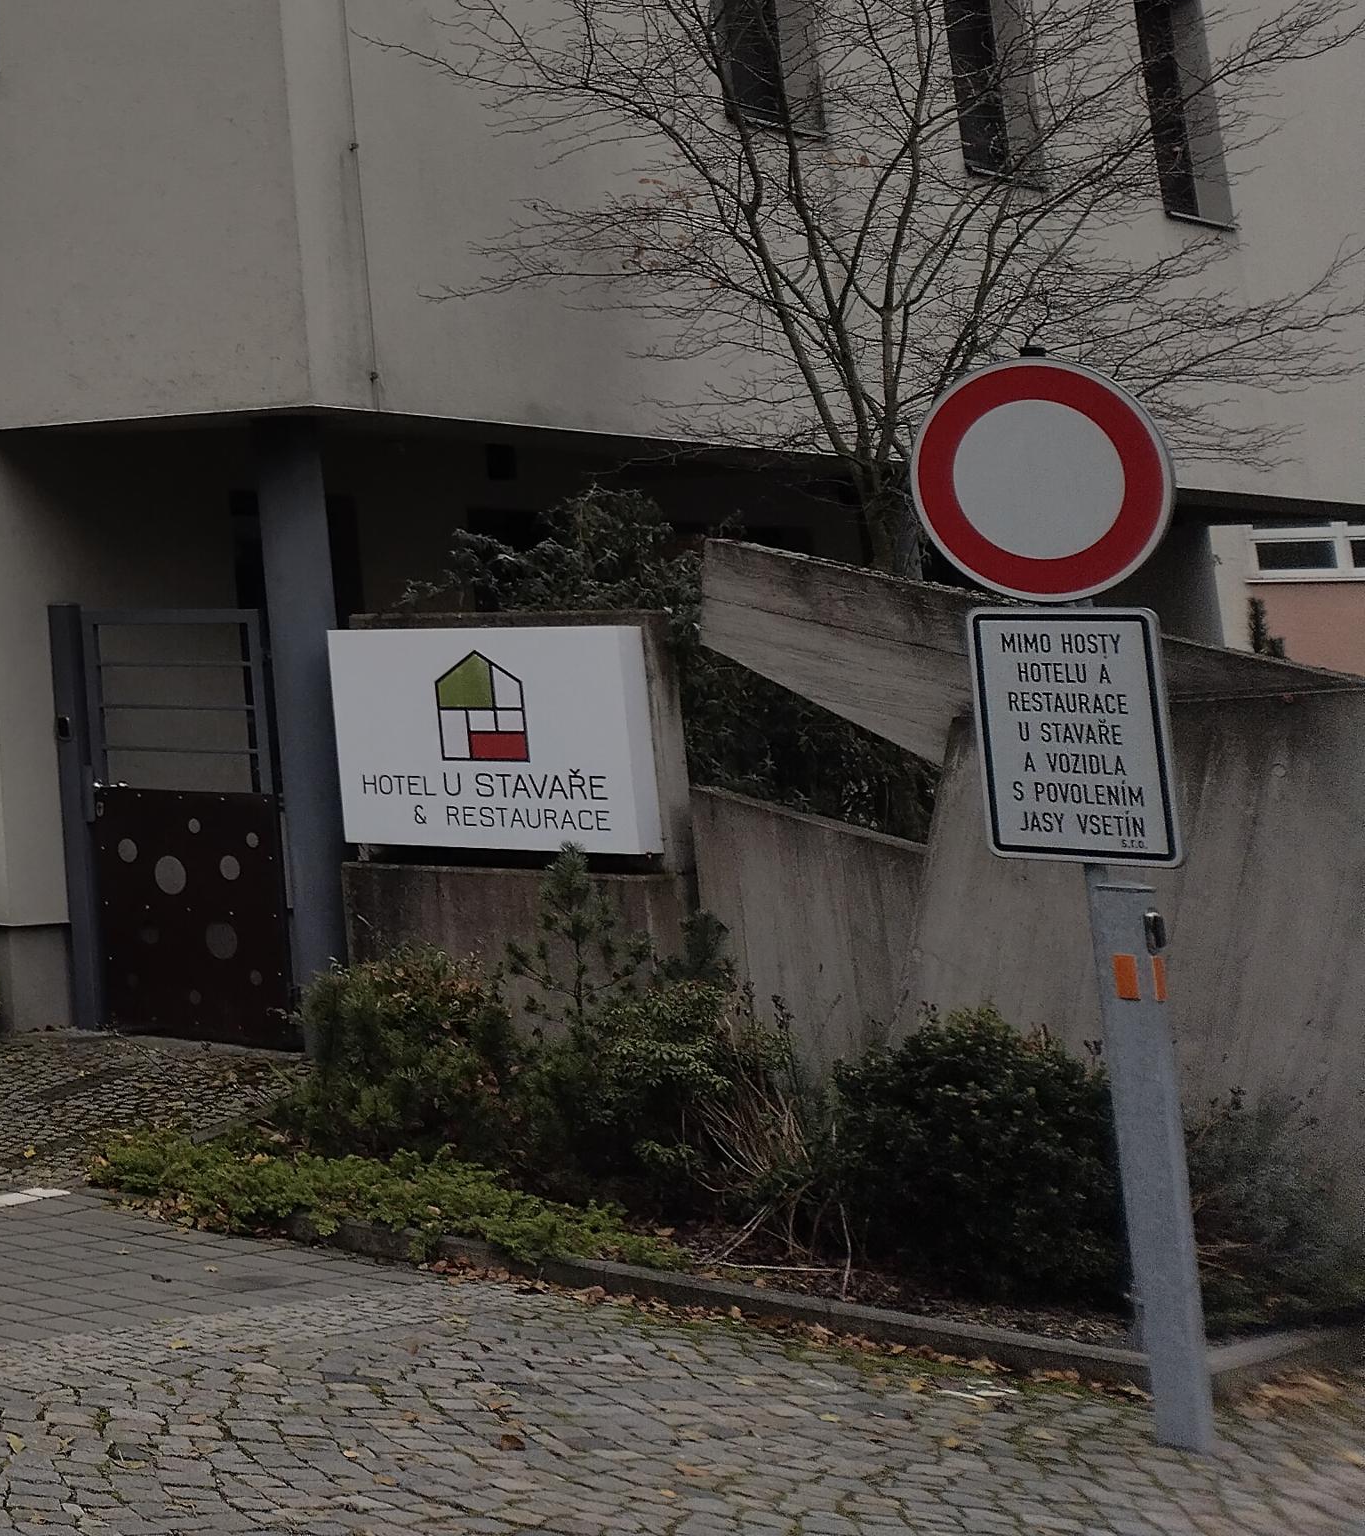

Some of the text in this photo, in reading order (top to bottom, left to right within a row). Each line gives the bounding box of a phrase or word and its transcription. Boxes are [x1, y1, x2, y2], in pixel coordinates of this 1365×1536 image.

[1000, 632, 1122, 655] MIMO HOSTY
[1017, 662, 1112, 685] HOTELU A
[1007, 691, 1129, 715] RESTAURACE
[1018, 719, 1123, 746] U STAVAŘE
[1023, 751, 1128, 777] A VOZIDLA
[361, 768, 609, 801] HOTEL U STAVAŘE
[1012, 779, 1145, 808] S POVOLENÍM
[413, 804, 612, 832] & RESTAURACE
[1019, 810, 1146, 838] JASY VSETÍN
